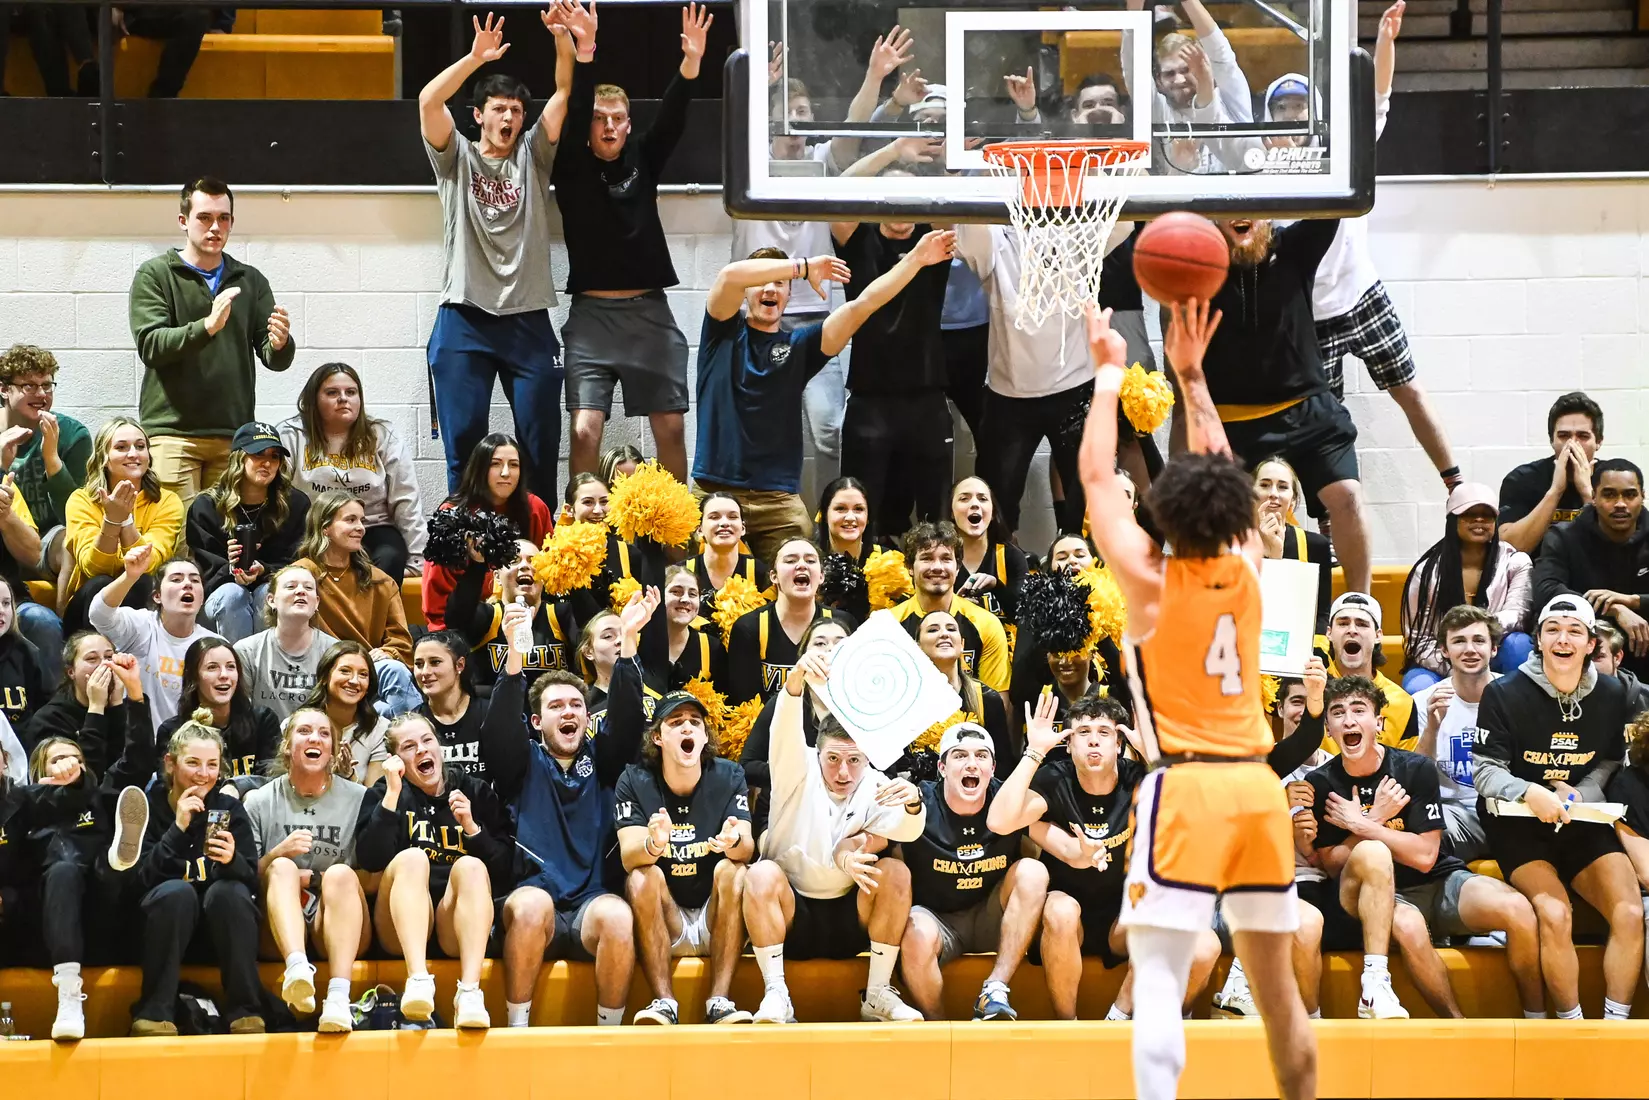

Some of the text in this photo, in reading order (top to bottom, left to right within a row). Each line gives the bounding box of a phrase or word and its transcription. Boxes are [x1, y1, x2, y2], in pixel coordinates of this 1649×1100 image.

[1267, 147, 1327, 161] SCHUTT
[472, 171, 513, 194] SPRNG
[311, 482, 371, 495] MADERS
[487, 643, 568, 673] VLLE
[1204, 612, 1244, 695] 4
[260, 690, 307, 703] LACRO
[1551, 738, 1579, 747] PSAC
[440, 741, 479, 763] LLE
[1543, 769, 1571, 781] 2021
[1425, 803, 1441, 820] 21
[283, 824, 341, 848] VLE
[669, 829, 695, 839] PSAC
[1102, 827, 1130, 849] PIONS
[306, 846, 346, 858] OSSE
[957, 847, 983, 856] PSAC
[671, 863, 697, 877] 2021
[933, 854, 1007, 876] CHAMPIONS
[956, 877, 983, 889] 2021
